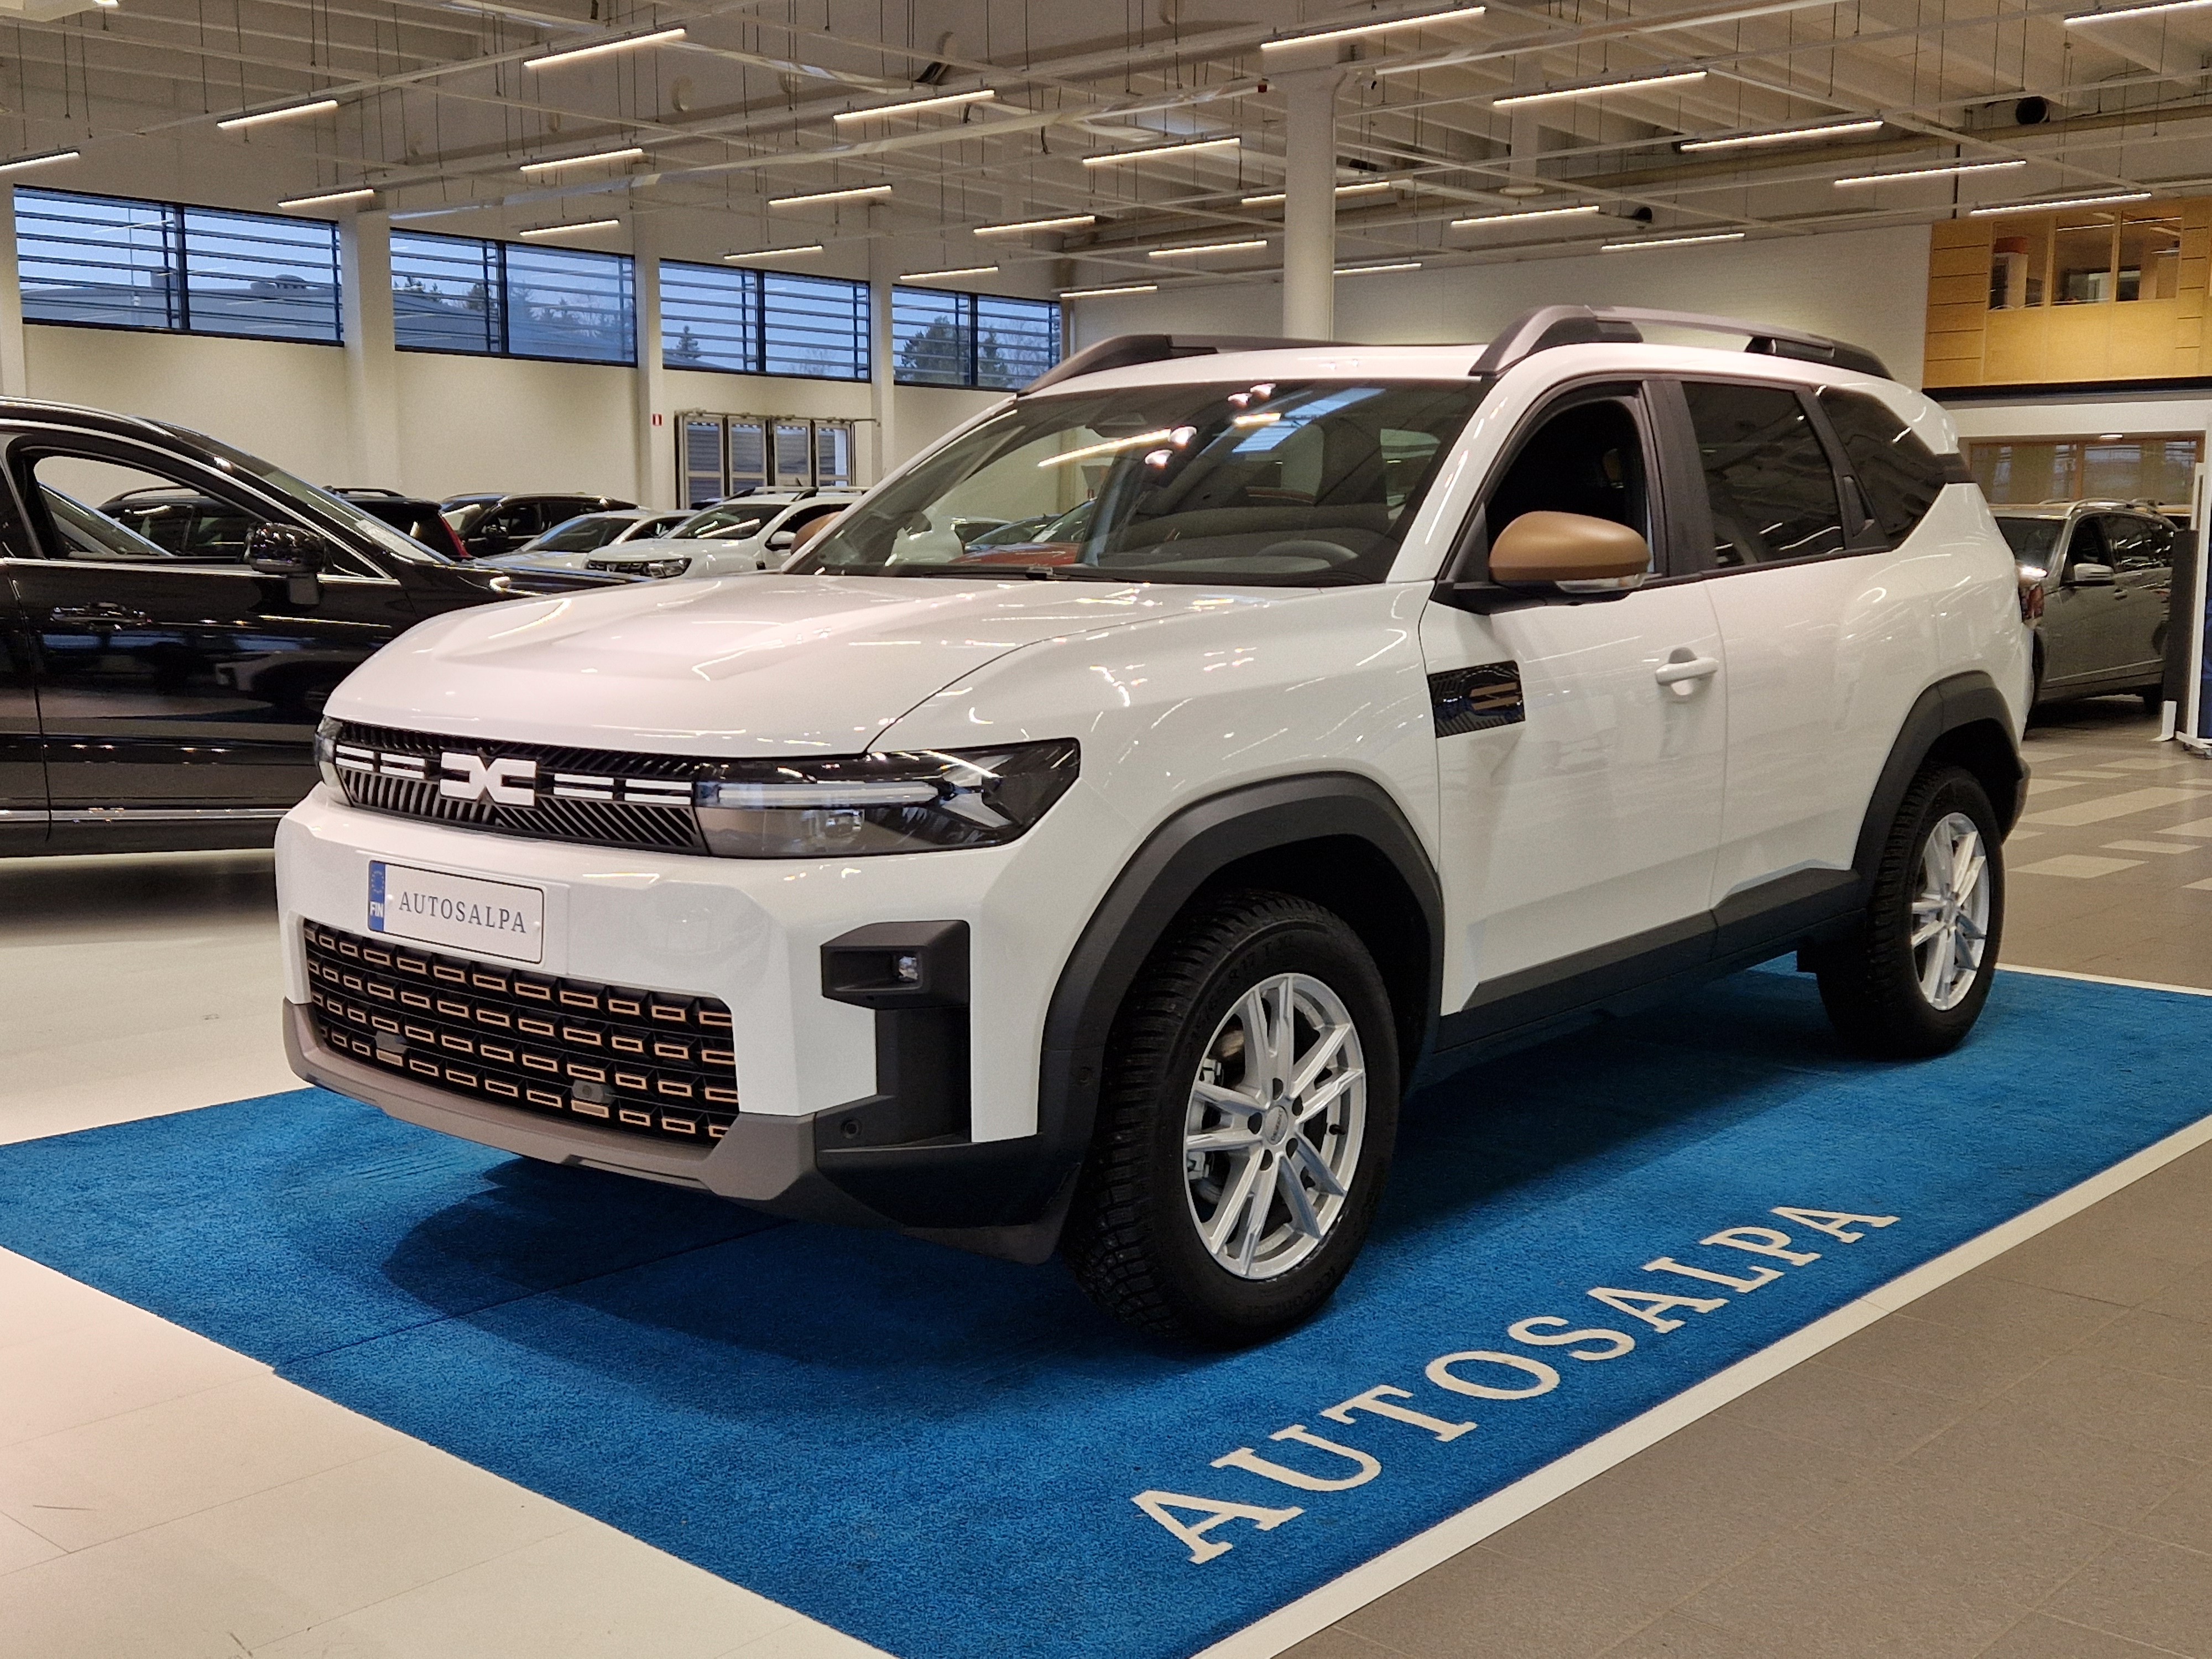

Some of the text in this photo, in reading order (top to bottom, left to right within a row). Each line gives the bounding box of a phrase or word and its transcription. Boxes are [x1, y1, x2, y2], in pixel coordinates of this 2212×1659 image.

[370, 901, 384, 917] FIN
[398, 891, 526, 933] AUTOSALPA
[1131, 1206, 1900, 1564] AUTOSALPA
